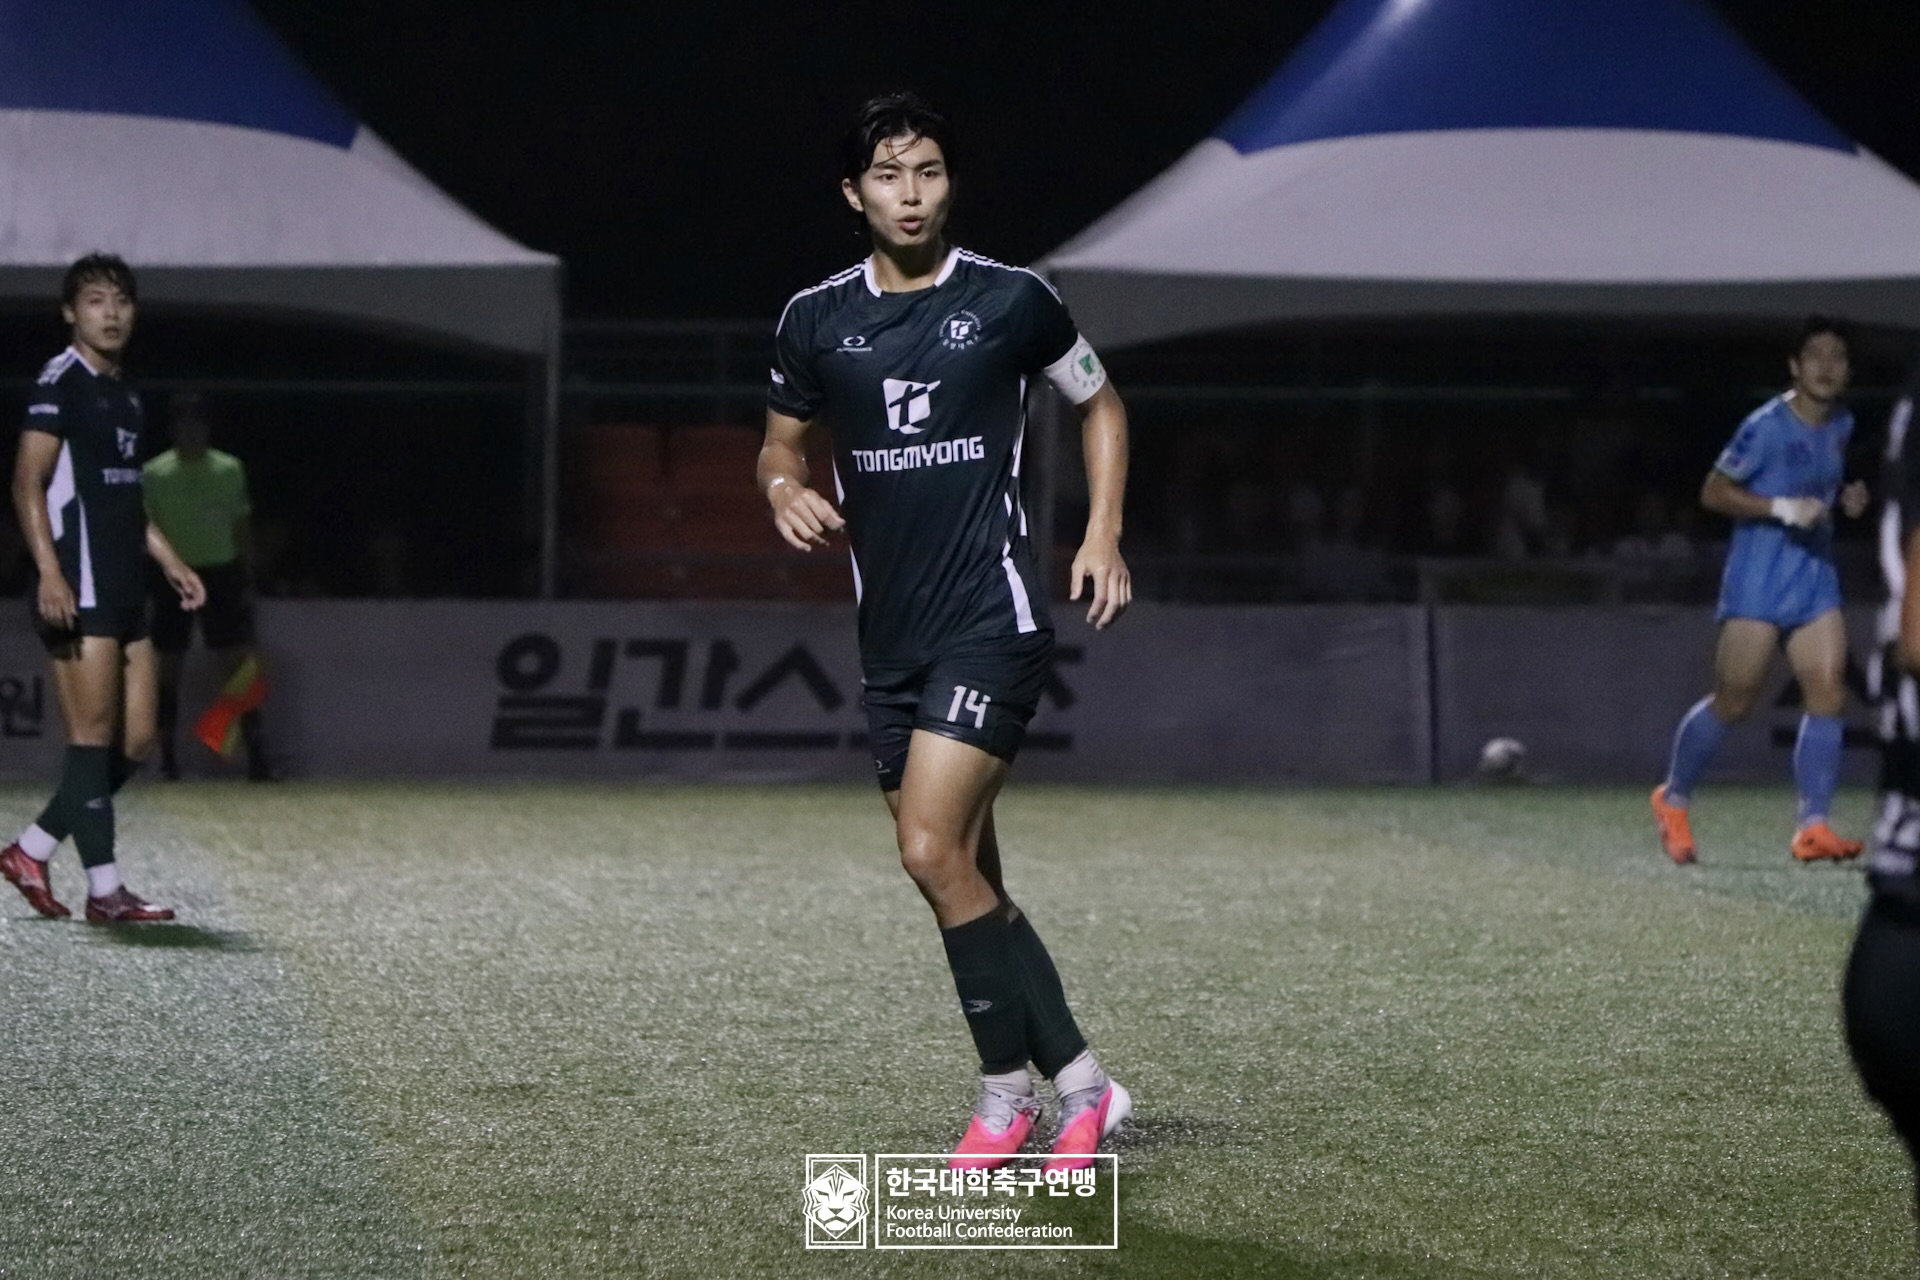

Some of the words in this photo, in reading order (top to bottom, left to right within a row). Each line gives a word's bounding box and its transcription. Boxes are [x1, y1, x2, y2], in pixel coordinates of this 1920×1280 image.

[852, 436, 984, 472] TONGMYONG
[489, 631, 1084, 751] 일간스
[947, 685, 991, 729] 14
